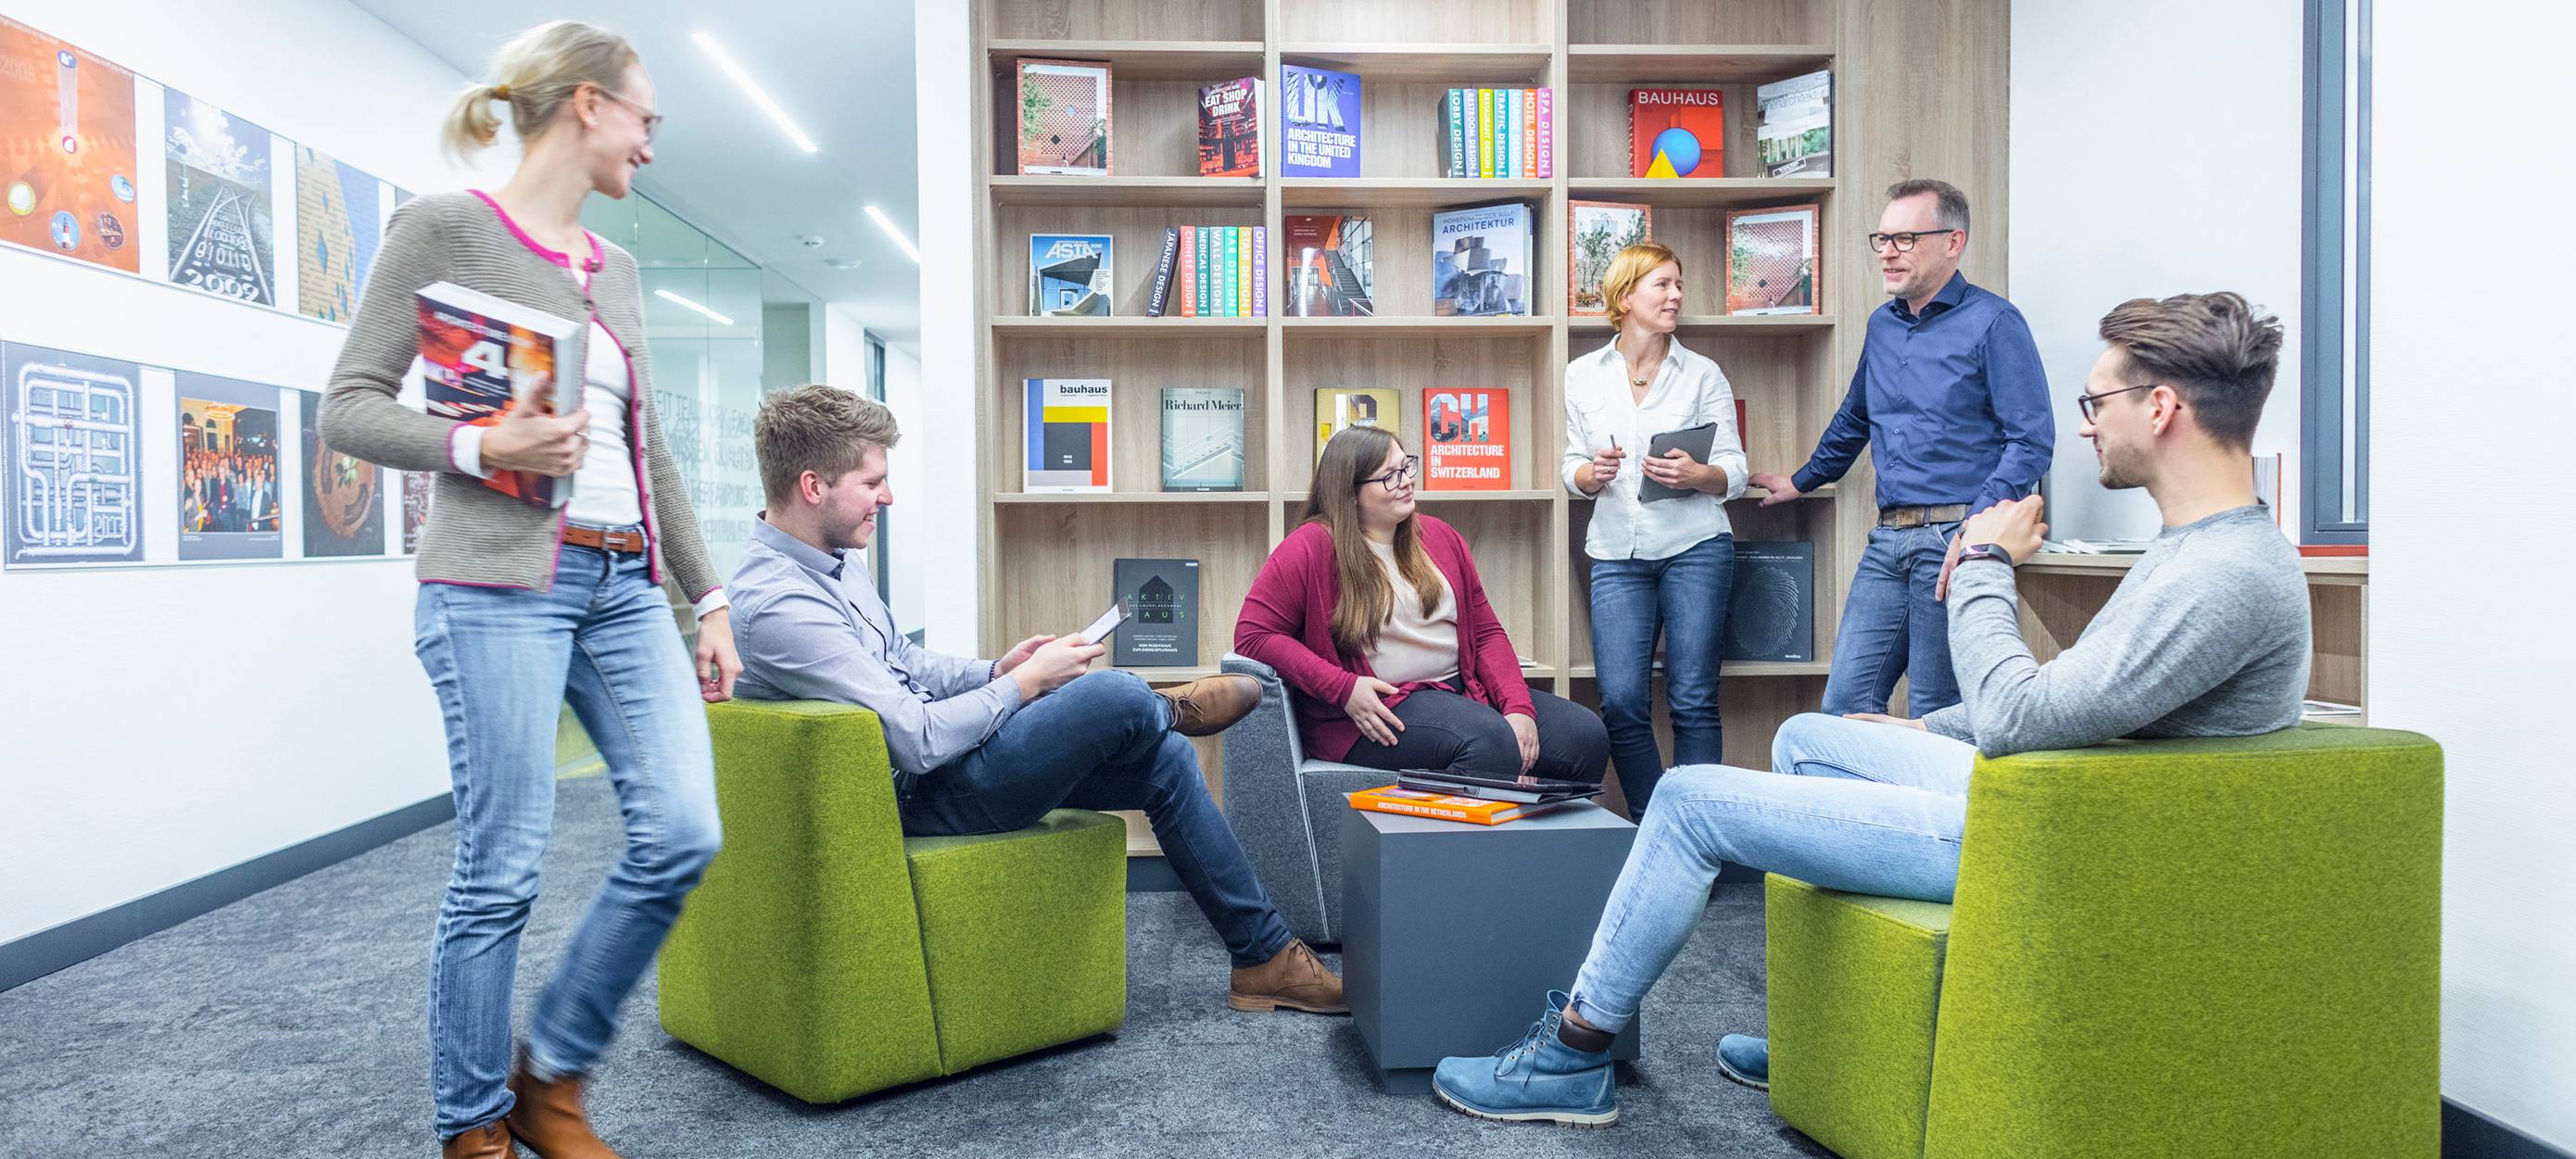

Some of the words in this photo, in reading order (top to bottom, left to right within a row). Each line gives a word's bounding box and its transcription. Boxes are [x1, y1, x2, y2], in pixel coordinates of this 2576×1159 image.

[0, 55, 36, 83] 2008
[1205, 94, 1221, 107] EAT
[1223, 88, 1248, 104] SHOP
[1212, 101, 1241, 118] DRINK
[1452, 92, 1461, 125] LOBBY
[1497, 93, 1506, 131] TRAFFIC
[1526, 93, 1535, 125] HOTEL
[1541, 93, 1550, 114] SPA
[1638, 92, 1719, 106] BAUHAUS
[1467, 94, 1475, 136] RESTROOM
[1287, 128, 1357, 147] ARCHITECTURE
[1287, 140, 1298, 153] IN
[1300, 142, 1318, 156] THE
[1319, 144, 1352, 158] UNITED
[1453, 130, 1463, 170] DESIGN
[1497, 134, 1506, 170] DESIGN
[1526, 130, 1535, 170] DESIGN
[1541, 121, 1550, 169] DESIGN
[1287, 153, 1332, 169] KINGDOM
[1469, 140, 1477, 170] DESIGN
[1228, 230, 1236, 254] BAR
[1443, 218, 1515, 234] ARCHITEKTUR
[1045, 243, 1098, 259] ASIA
[1159, 231, 1176, 273] JAPANESE
[1184, 231, 1193, 270] CHINESE
[1198, 230, 1206, 270] MEDICAL
[1213, 230, 1221, 258] WALL
[1242, 231, 1250, 260] STAIR
[1255, 231, 1264, 265] OFFICE
[183, 268, 260, 302] 2009
[1151, 274, 1166, 308] DESIGN
[1185, 274, 1193, 308] DESIGN
[1199, 273, 1207, 308] DESIGN
[1213, 265, 1221, 307] DESIGN
[1228, 260, 1237, 308] DESIGN
[1242, 266, 1250, 308] DESIGN
[1255, 270, 1264, 308] DESIGN
[461, 341, 510, 379] 4
[1059, 384, 1108, 394] bauhaus
[1165, 399, 1209, 411] Richard
[1211, 399, 1242, 411] Meier
[1431, 393, 1489, 443] CH
[1431, 444, 1504, 457] ARCHITECTURE
[1431, 456, 1442, 467] IN
[1431, 467, 1500, 479] SWITZERLAND
[1377, 801, 1414, 813] ARCHITECTURE
[1421, 806, 1430, 815] THE
